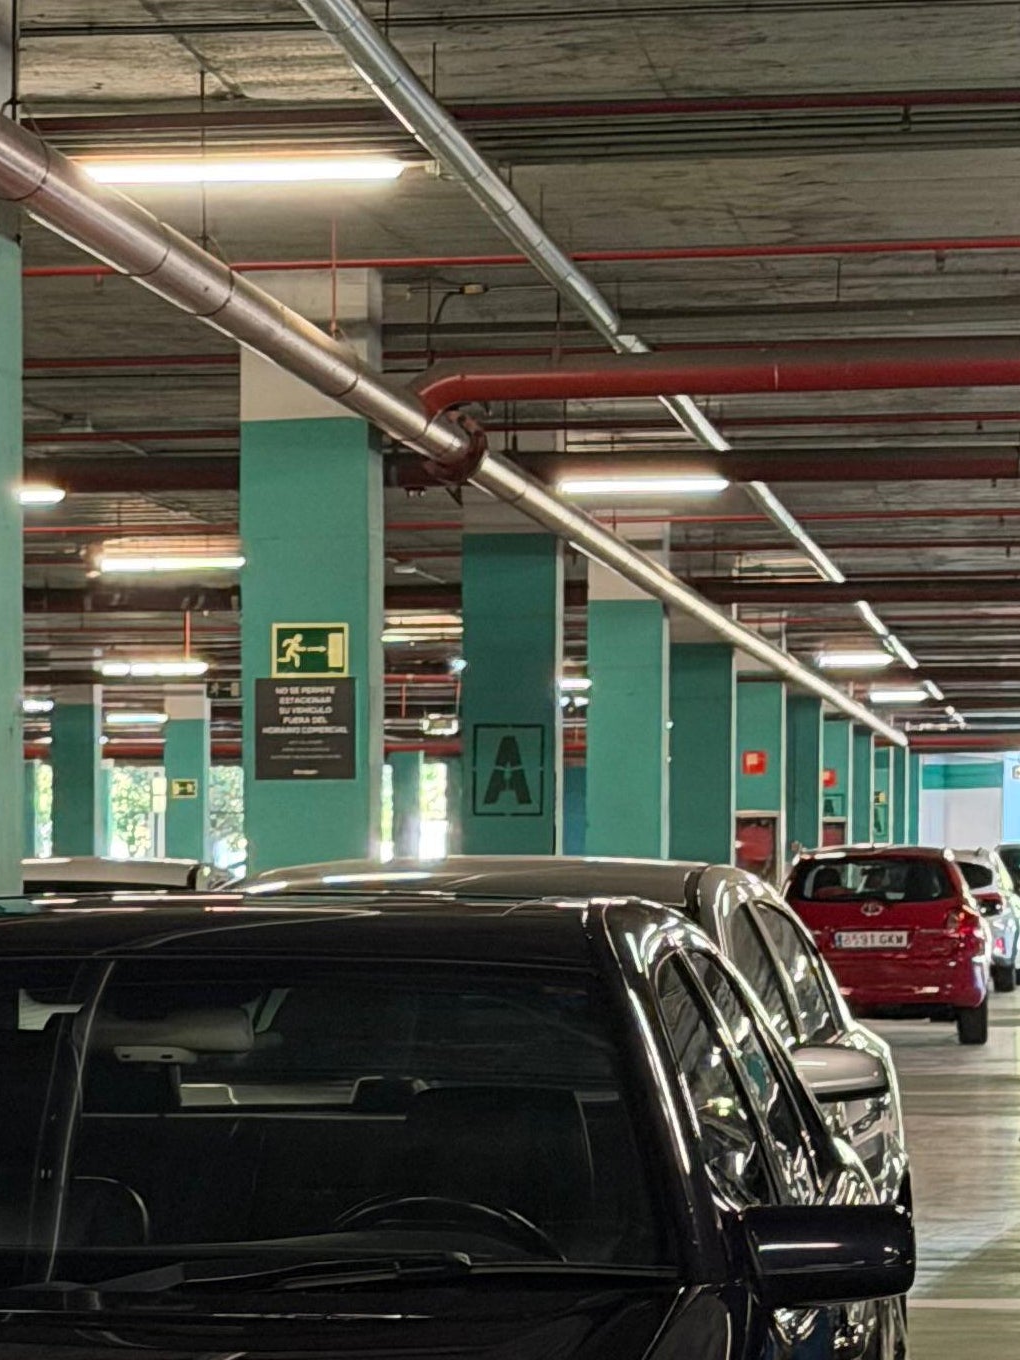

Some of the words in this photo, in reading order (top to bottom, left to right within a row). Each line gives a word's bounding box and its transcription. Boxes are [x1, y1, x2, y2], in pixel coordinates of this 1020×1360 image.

[275, 686, 288, 694] NO
[290, 686, 300, 694] SE
[301, 686, 335, 694] PERMITE
[279, 707, 290, 715] SU
[283, 716, 310, 724] FUERA
[312, 716, 328, 724] DEL
[483, 735, 533, 805] A
